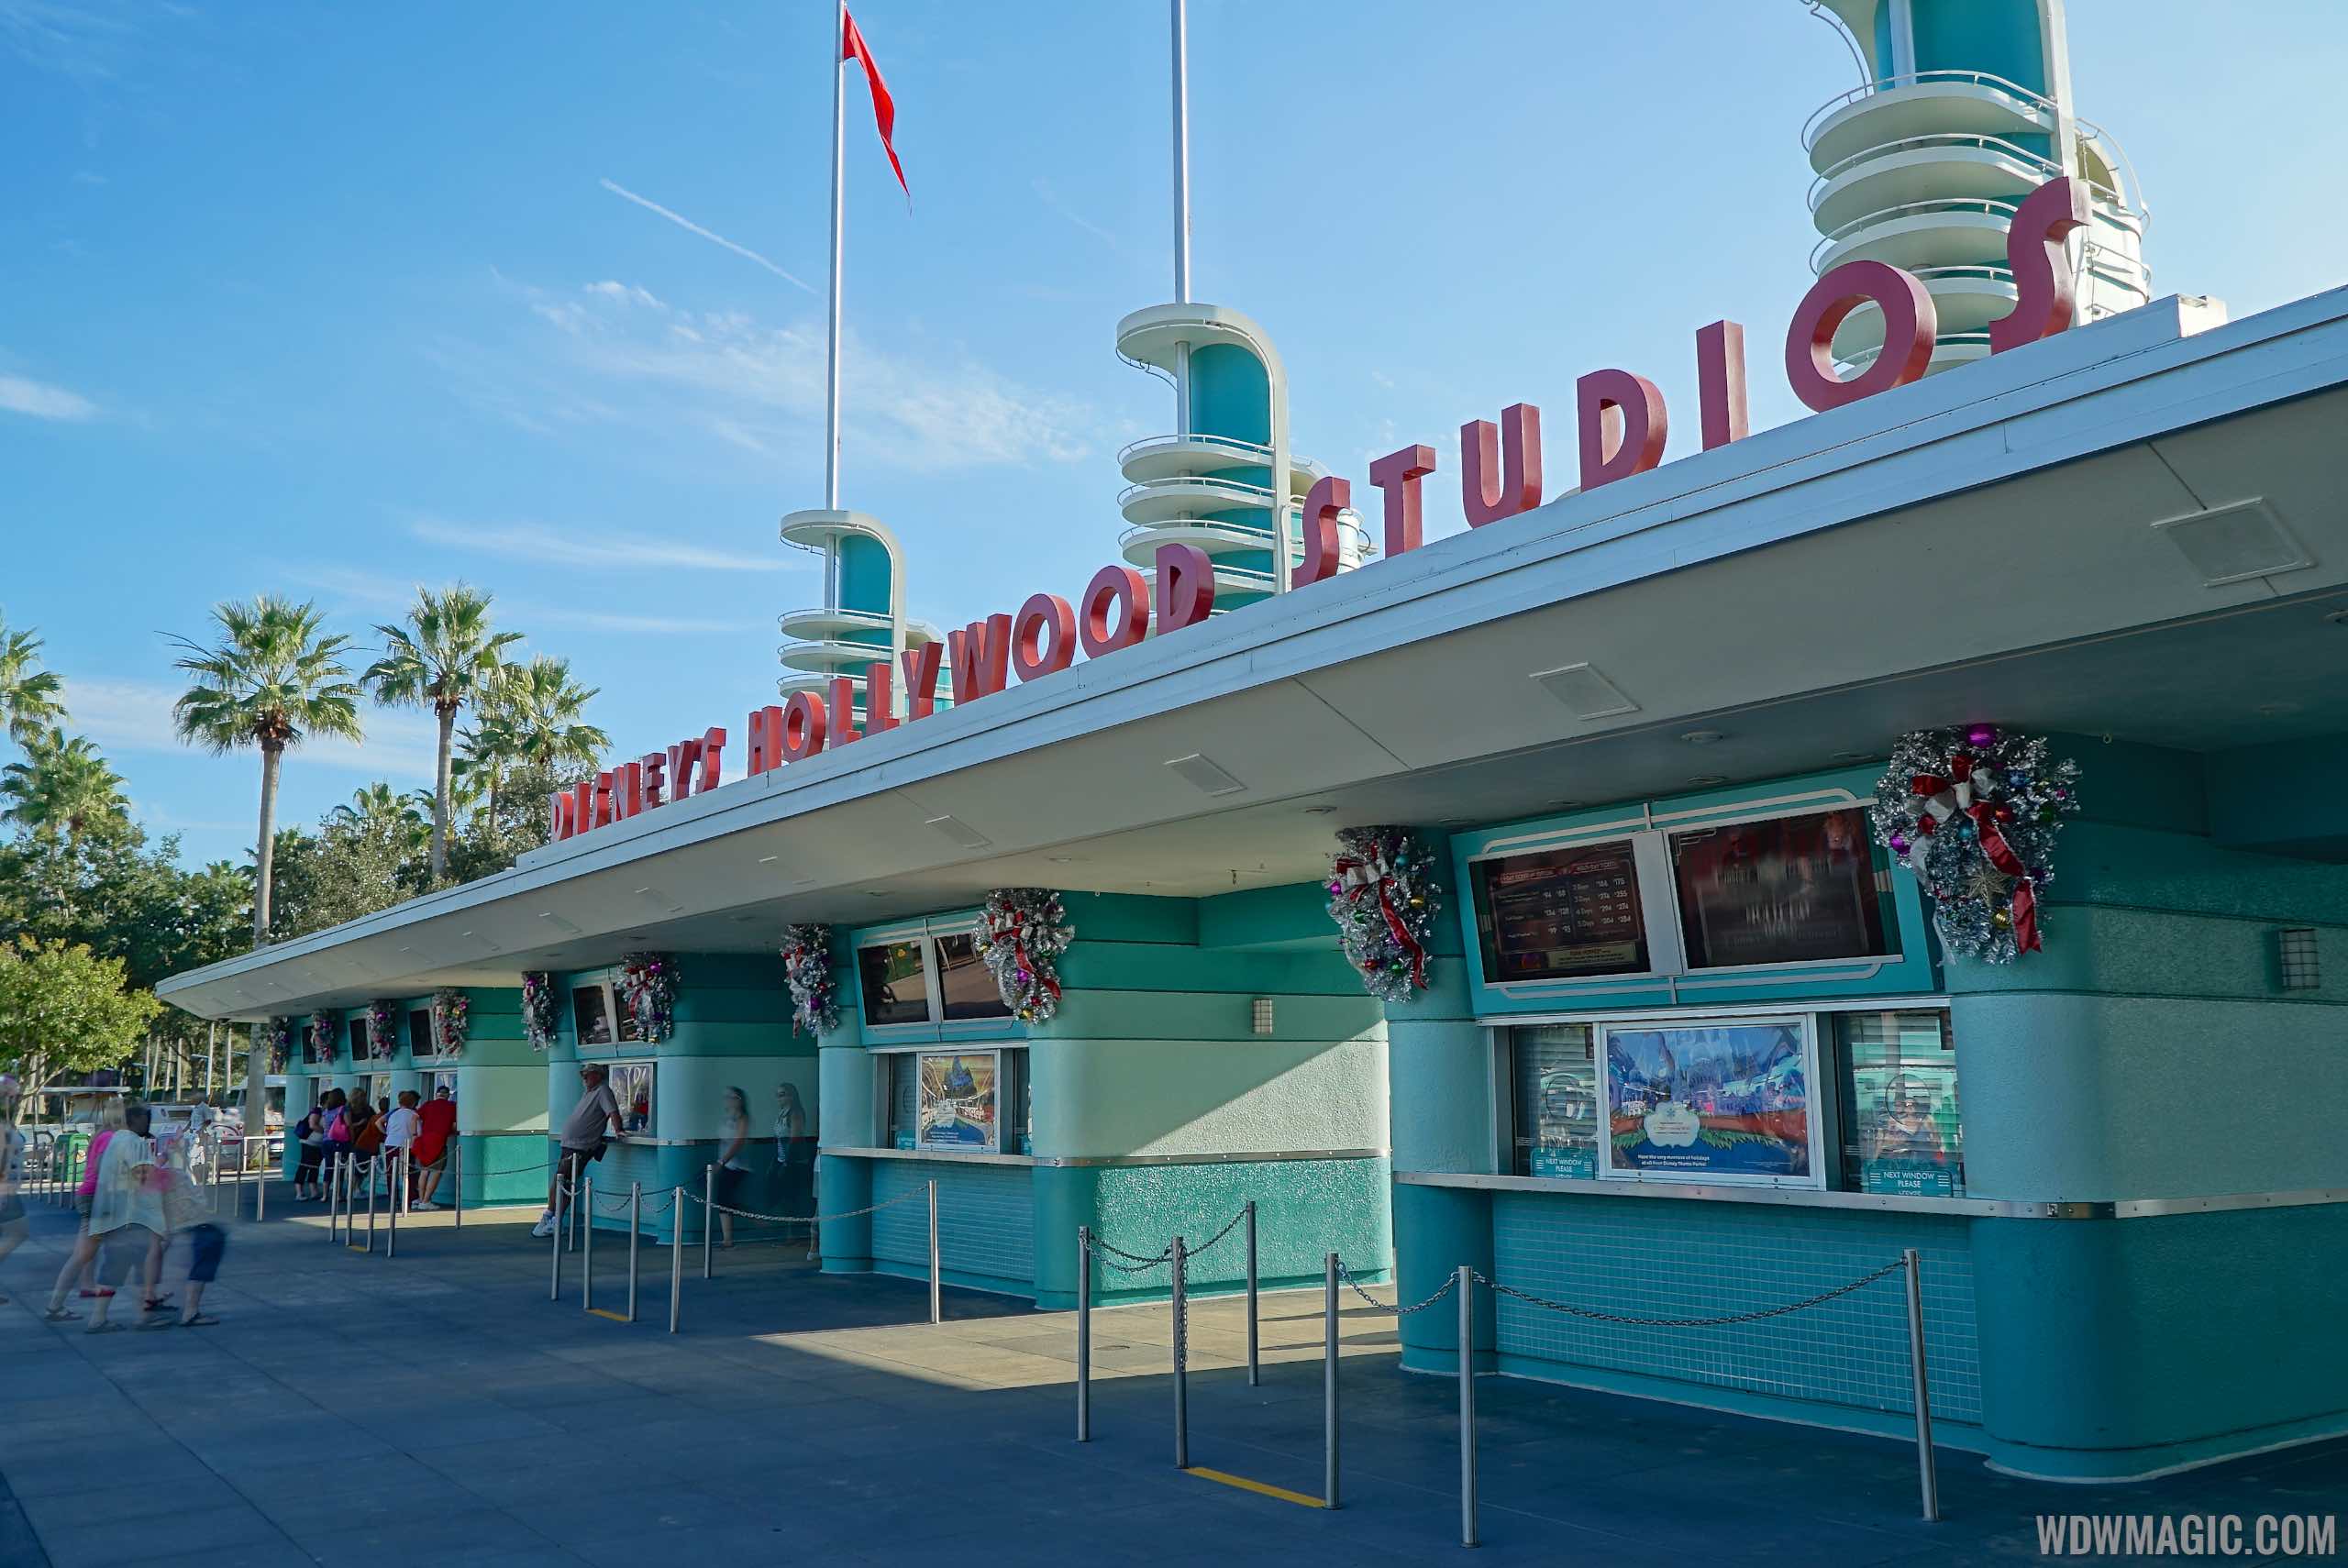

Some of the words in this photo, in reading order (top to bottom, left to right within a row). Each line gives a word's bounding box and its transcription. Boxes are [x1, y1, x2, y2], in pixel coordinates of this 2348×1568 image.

[551, 727, 726, 842] DISNEY'S
[748, 543, 1215, 778] HOLLYWOOD
[1292, 175, 2091, 588] STUDIOS
[1883, 1171, 1900, 1179] NEXT
[1901, 1172, 1935, 1180] WINDOW
[1897, 1180, 1922, 1188] PLEASE
